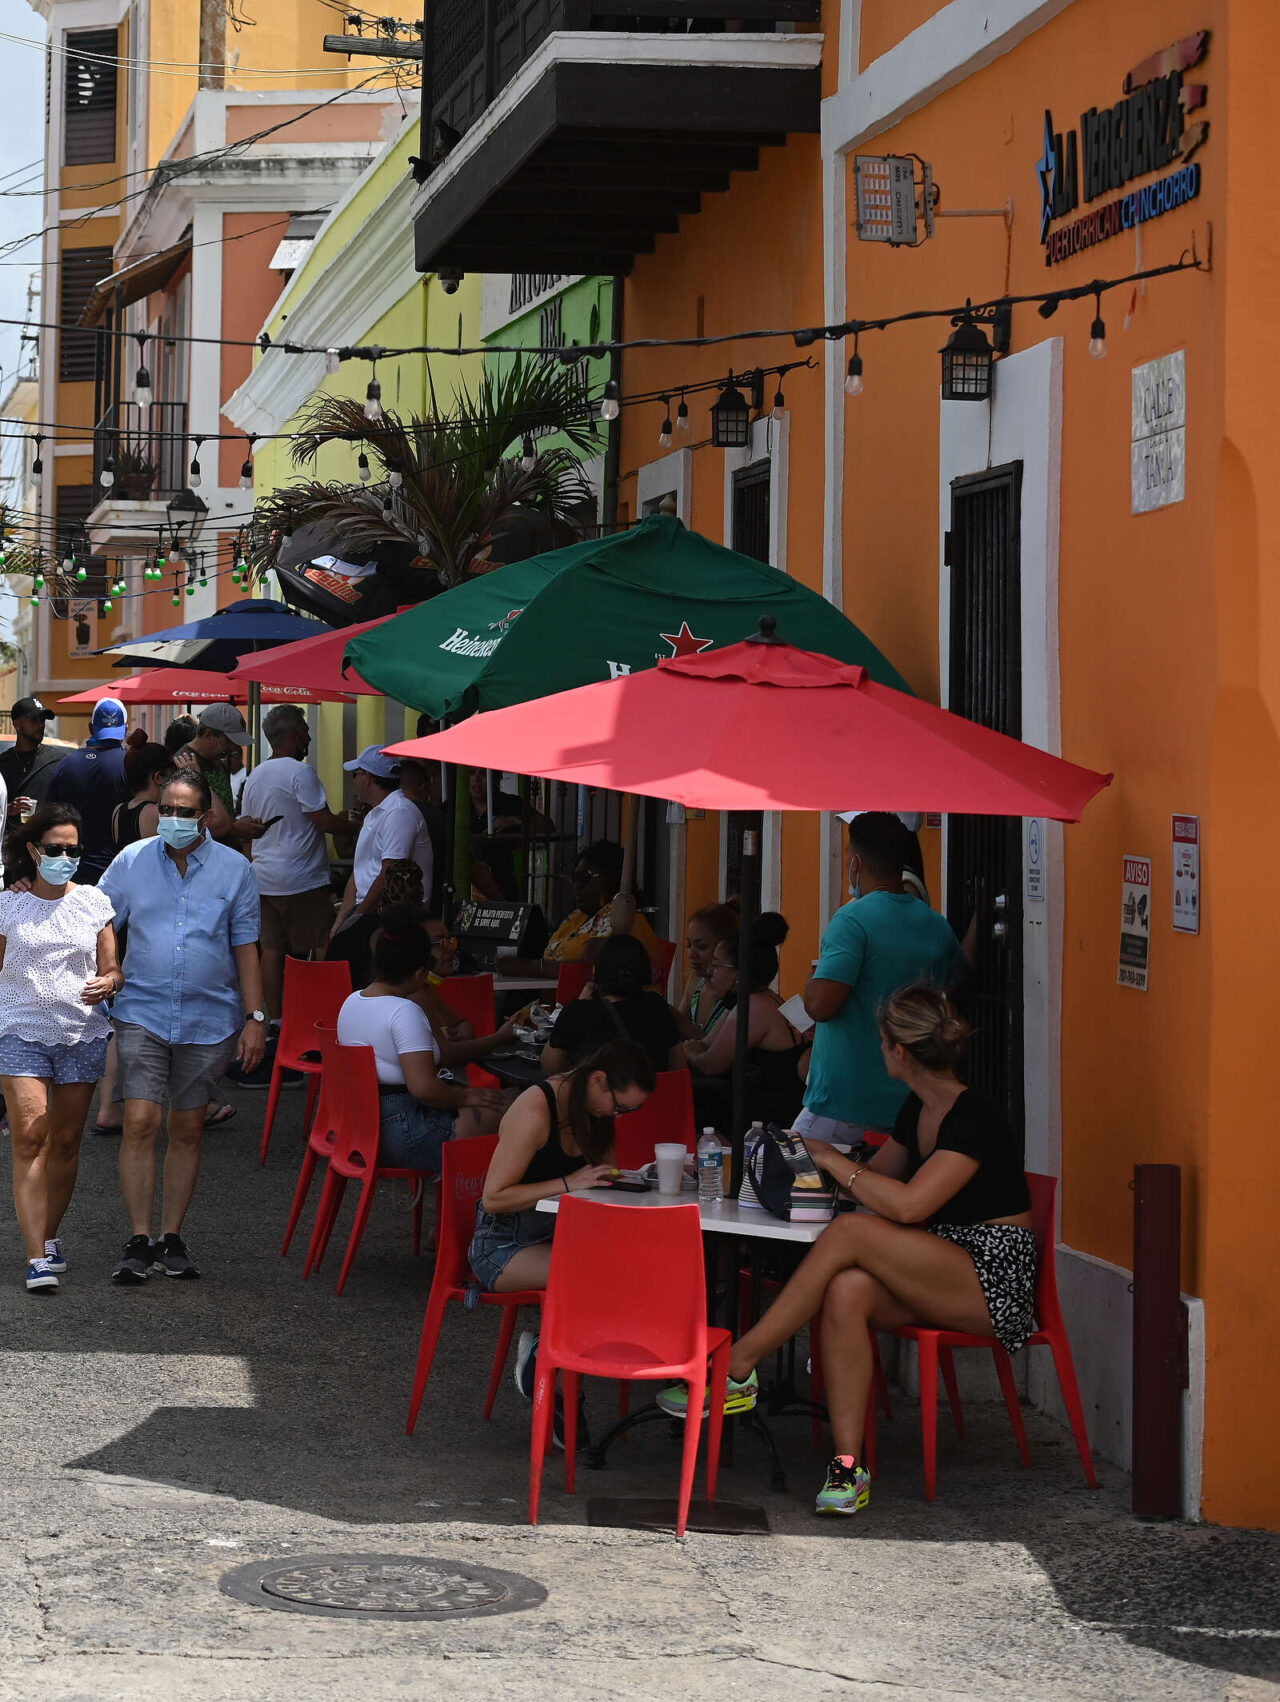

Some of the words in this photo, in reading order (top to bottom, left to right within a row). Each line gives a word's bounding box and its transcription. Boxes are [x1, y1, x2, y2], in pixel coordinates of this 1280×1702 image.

[1045, 200, 1123, 267] PUERTORRICAN
[1121, 162, 1200, 229] CHINCHORRO
[1053, 130, 1078, 221] LA
[1125, 861, 1149, 885] AVISO
